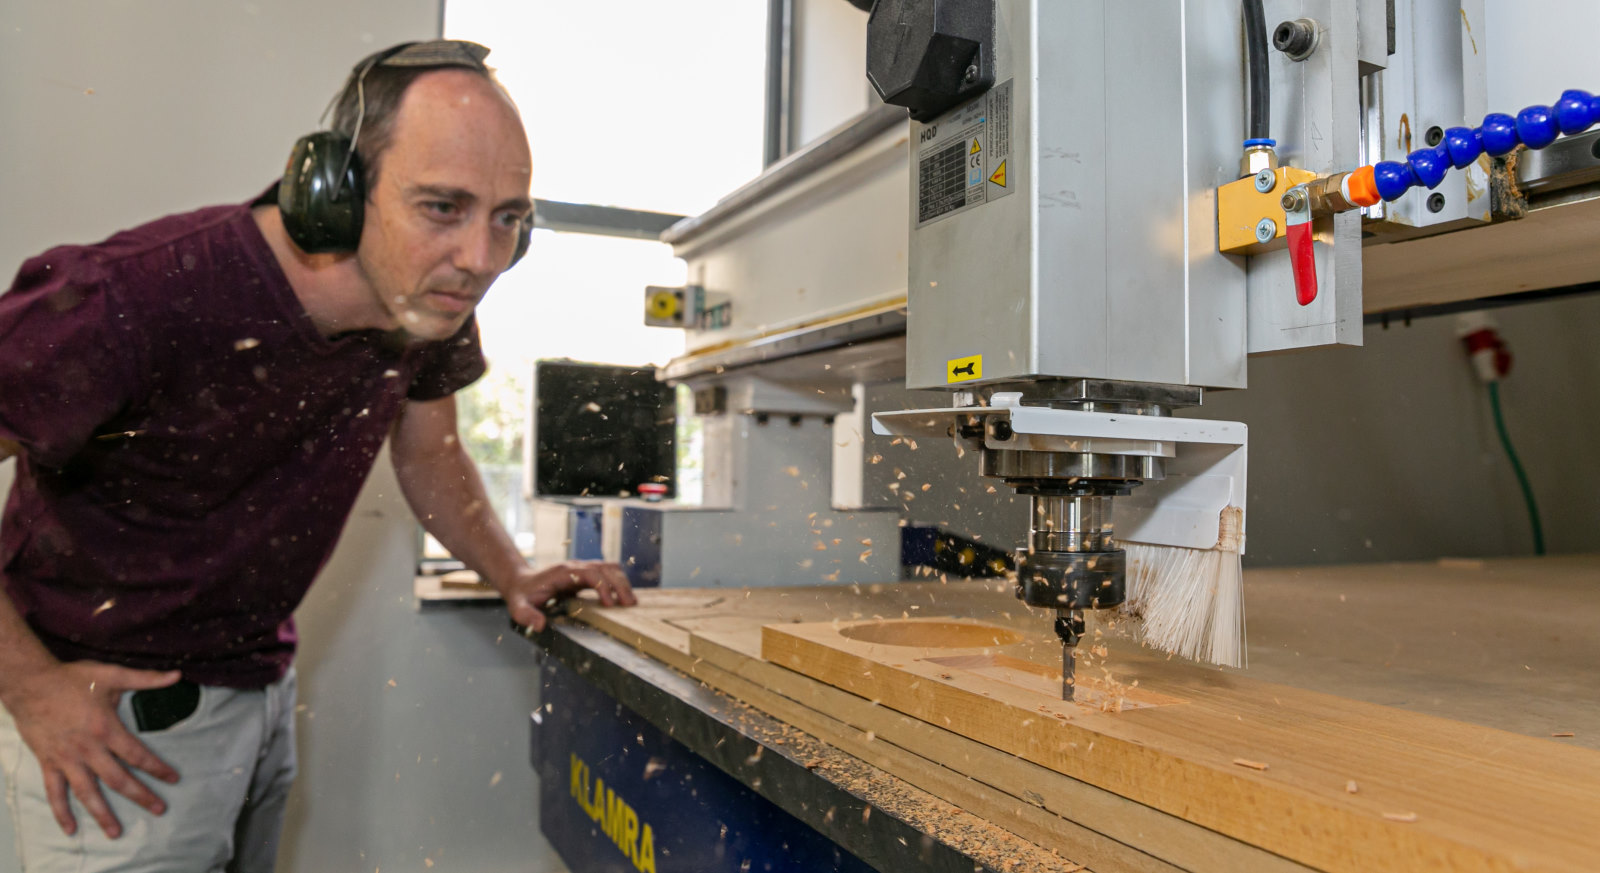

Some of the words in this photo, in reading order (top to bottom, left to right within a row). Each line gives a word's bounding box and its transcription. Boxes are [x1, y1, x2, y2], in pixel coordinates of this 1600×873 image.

[920, 126, 937, 144] HQD
[970, 154, 981, 168] CE
[571, 752, 656, 873] KLAMRA
